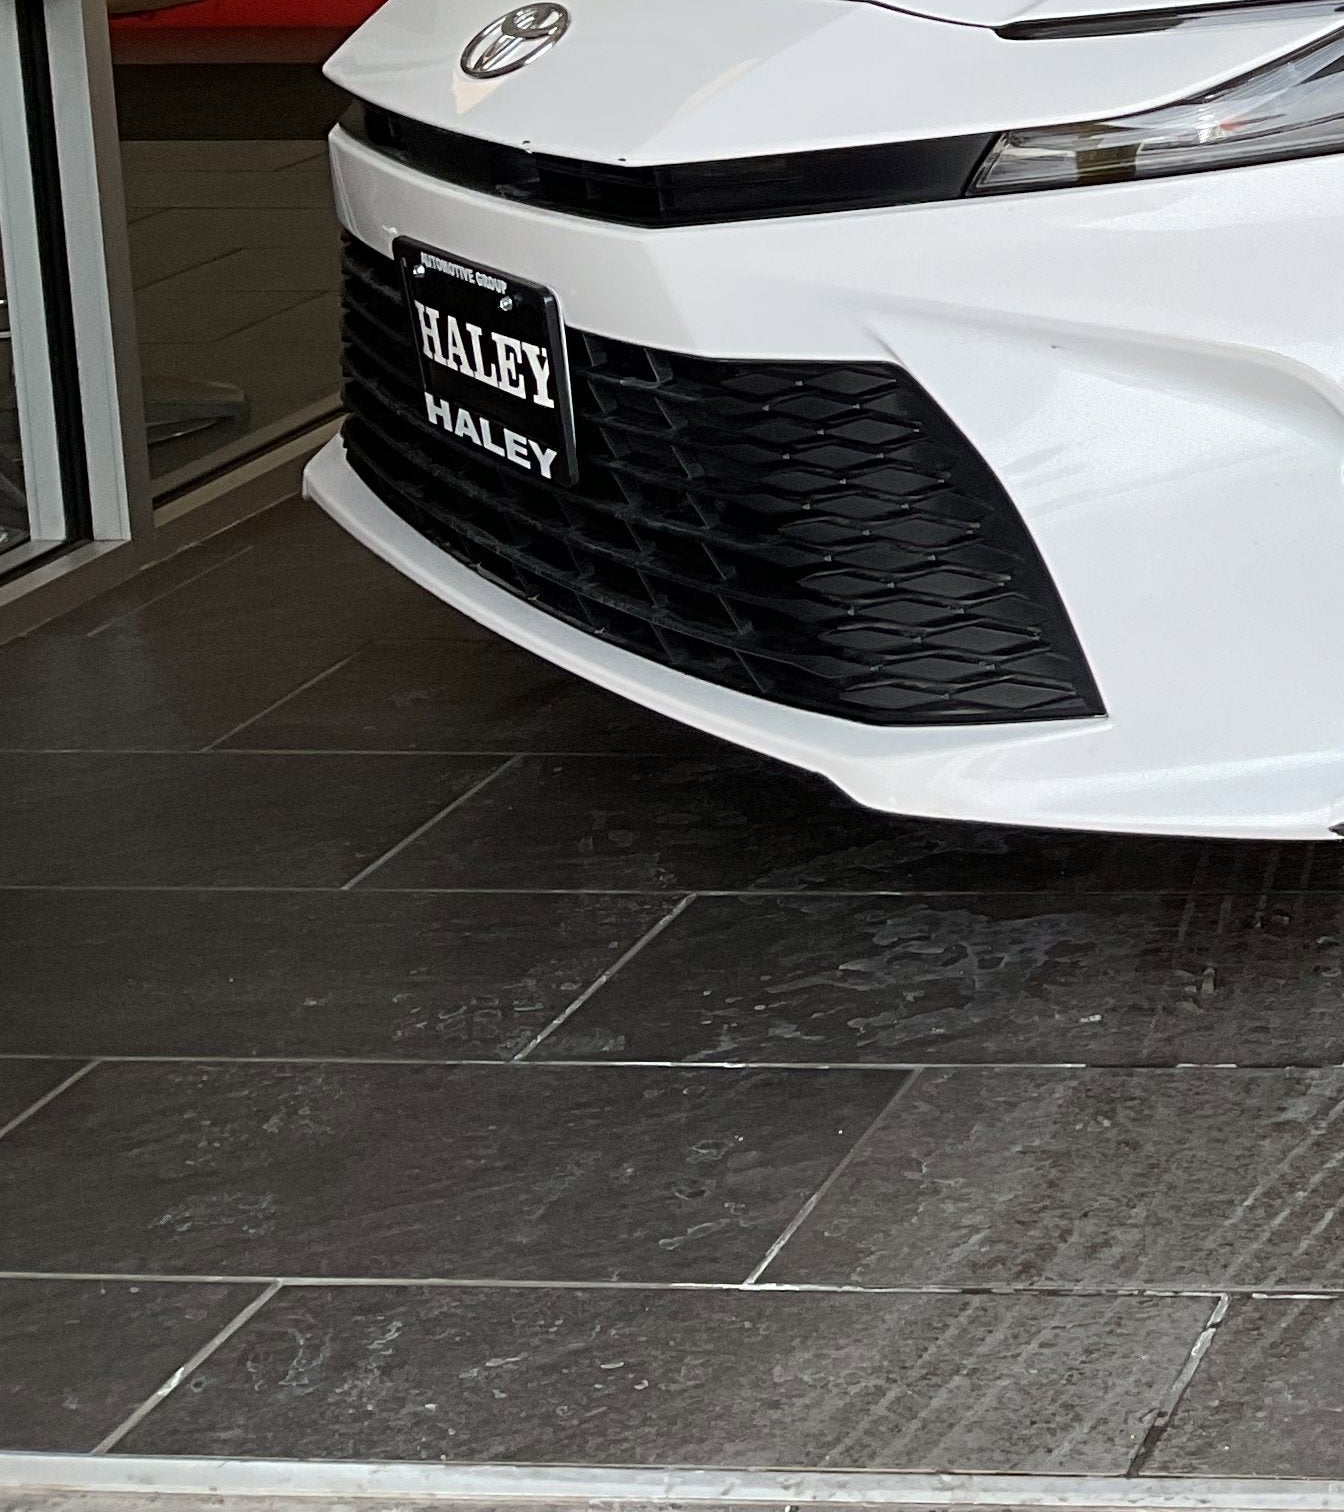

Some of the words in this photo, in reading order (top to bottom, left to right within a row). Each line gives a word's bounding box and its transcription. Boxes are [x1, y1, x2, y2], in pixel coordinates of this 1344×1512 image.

[420, 251, 475, 285] AUTOMOTIVE
[475, 270, 508, 295] GROUP
[414, 299, 555, 409] HALEY
[424, 391, 557, 480] HALEY
